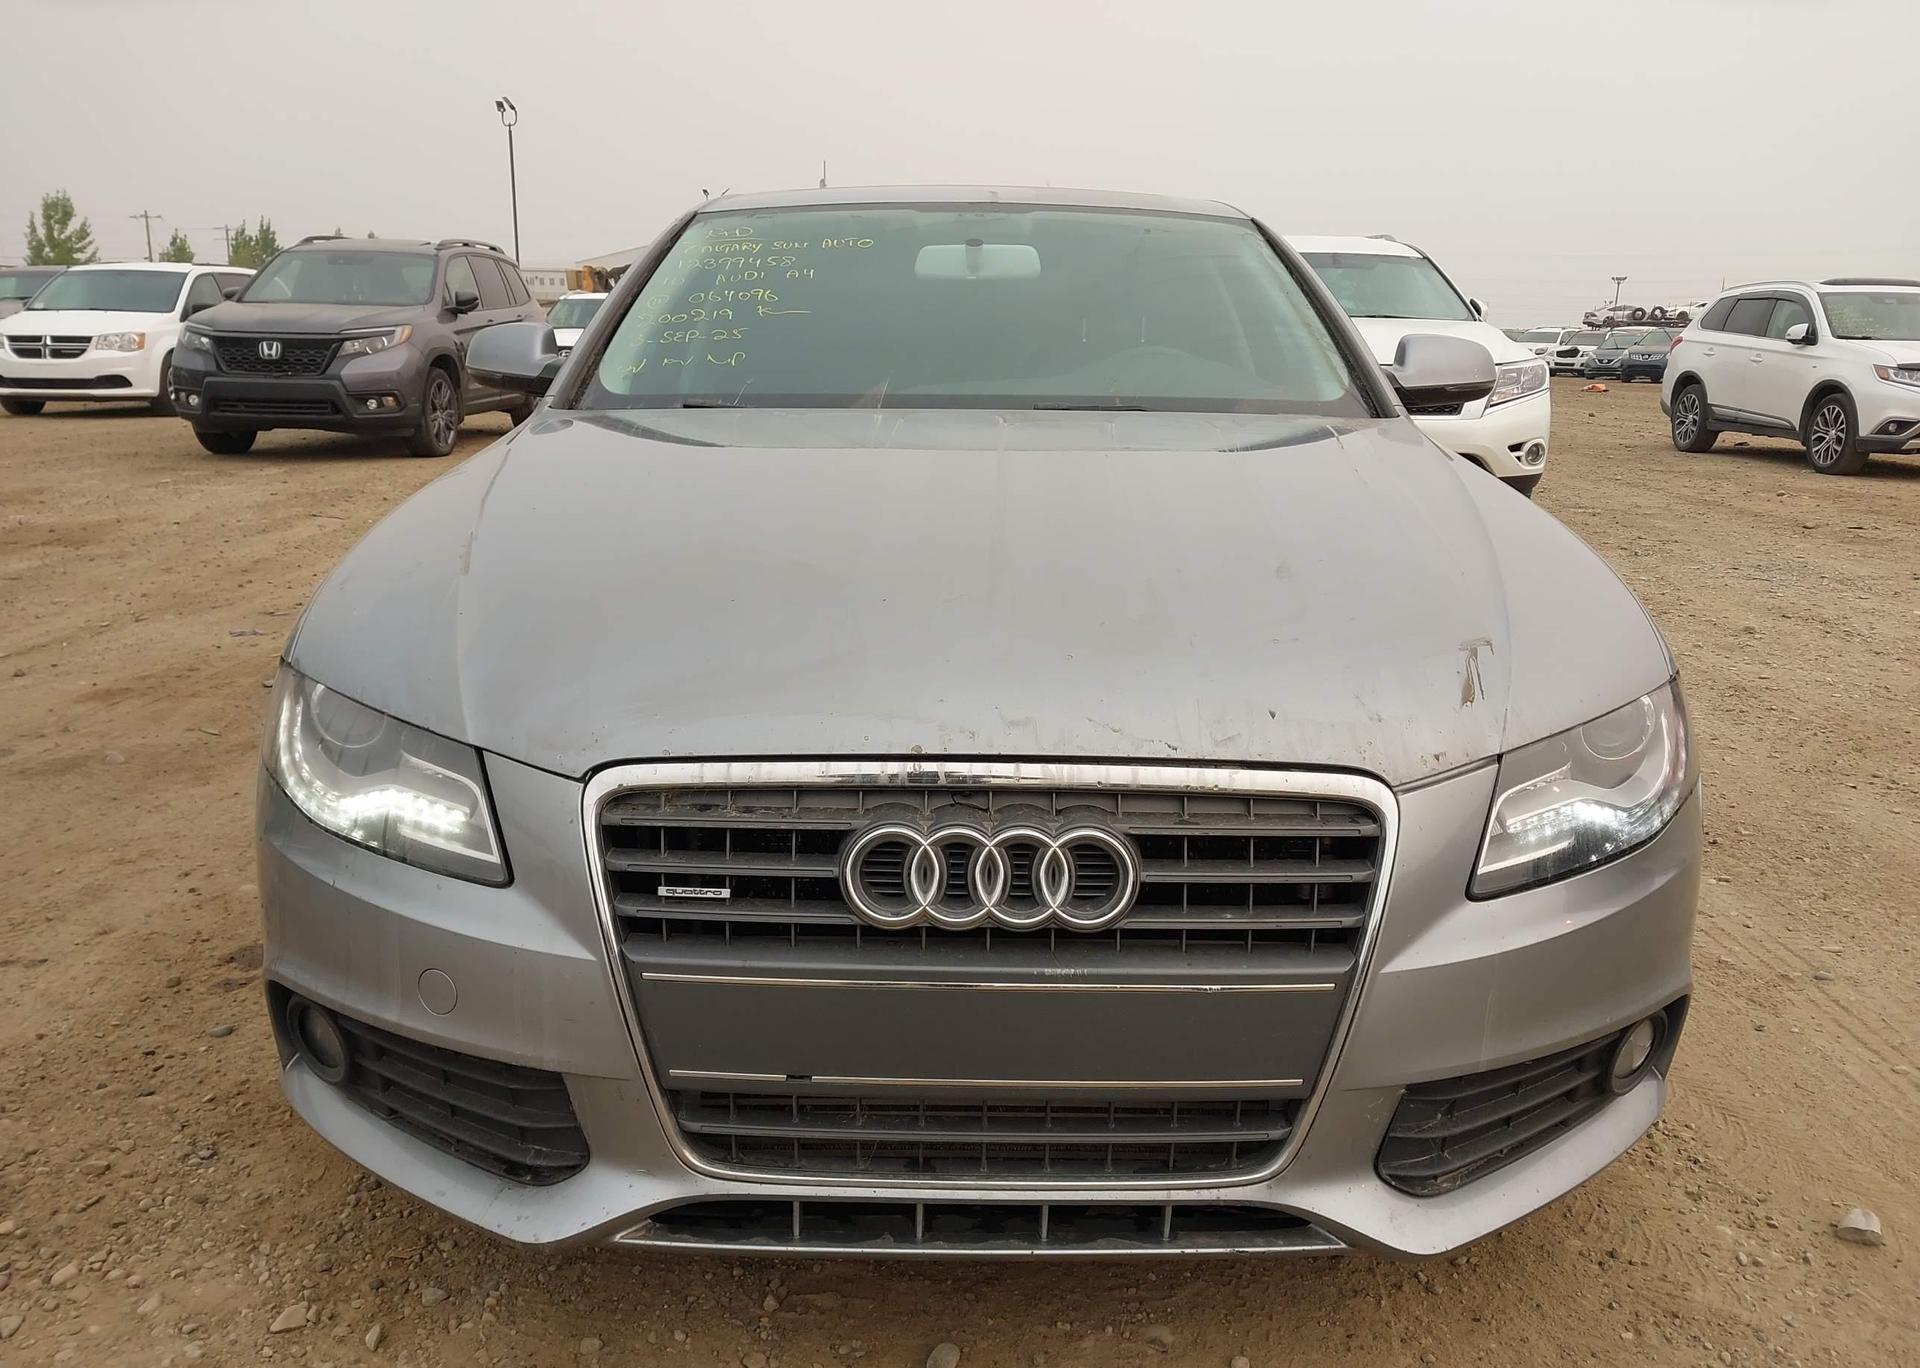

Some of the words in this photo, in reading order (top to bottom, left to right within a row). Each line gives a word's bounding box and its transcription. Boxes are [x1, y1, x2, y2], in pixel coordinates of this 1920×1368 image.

[822, 237, 875, 249] AUTO
[715, 271, 764, 286] AUDI
[786, 269, 817, 280] A4
[665, 888, 722, 896] quattro
